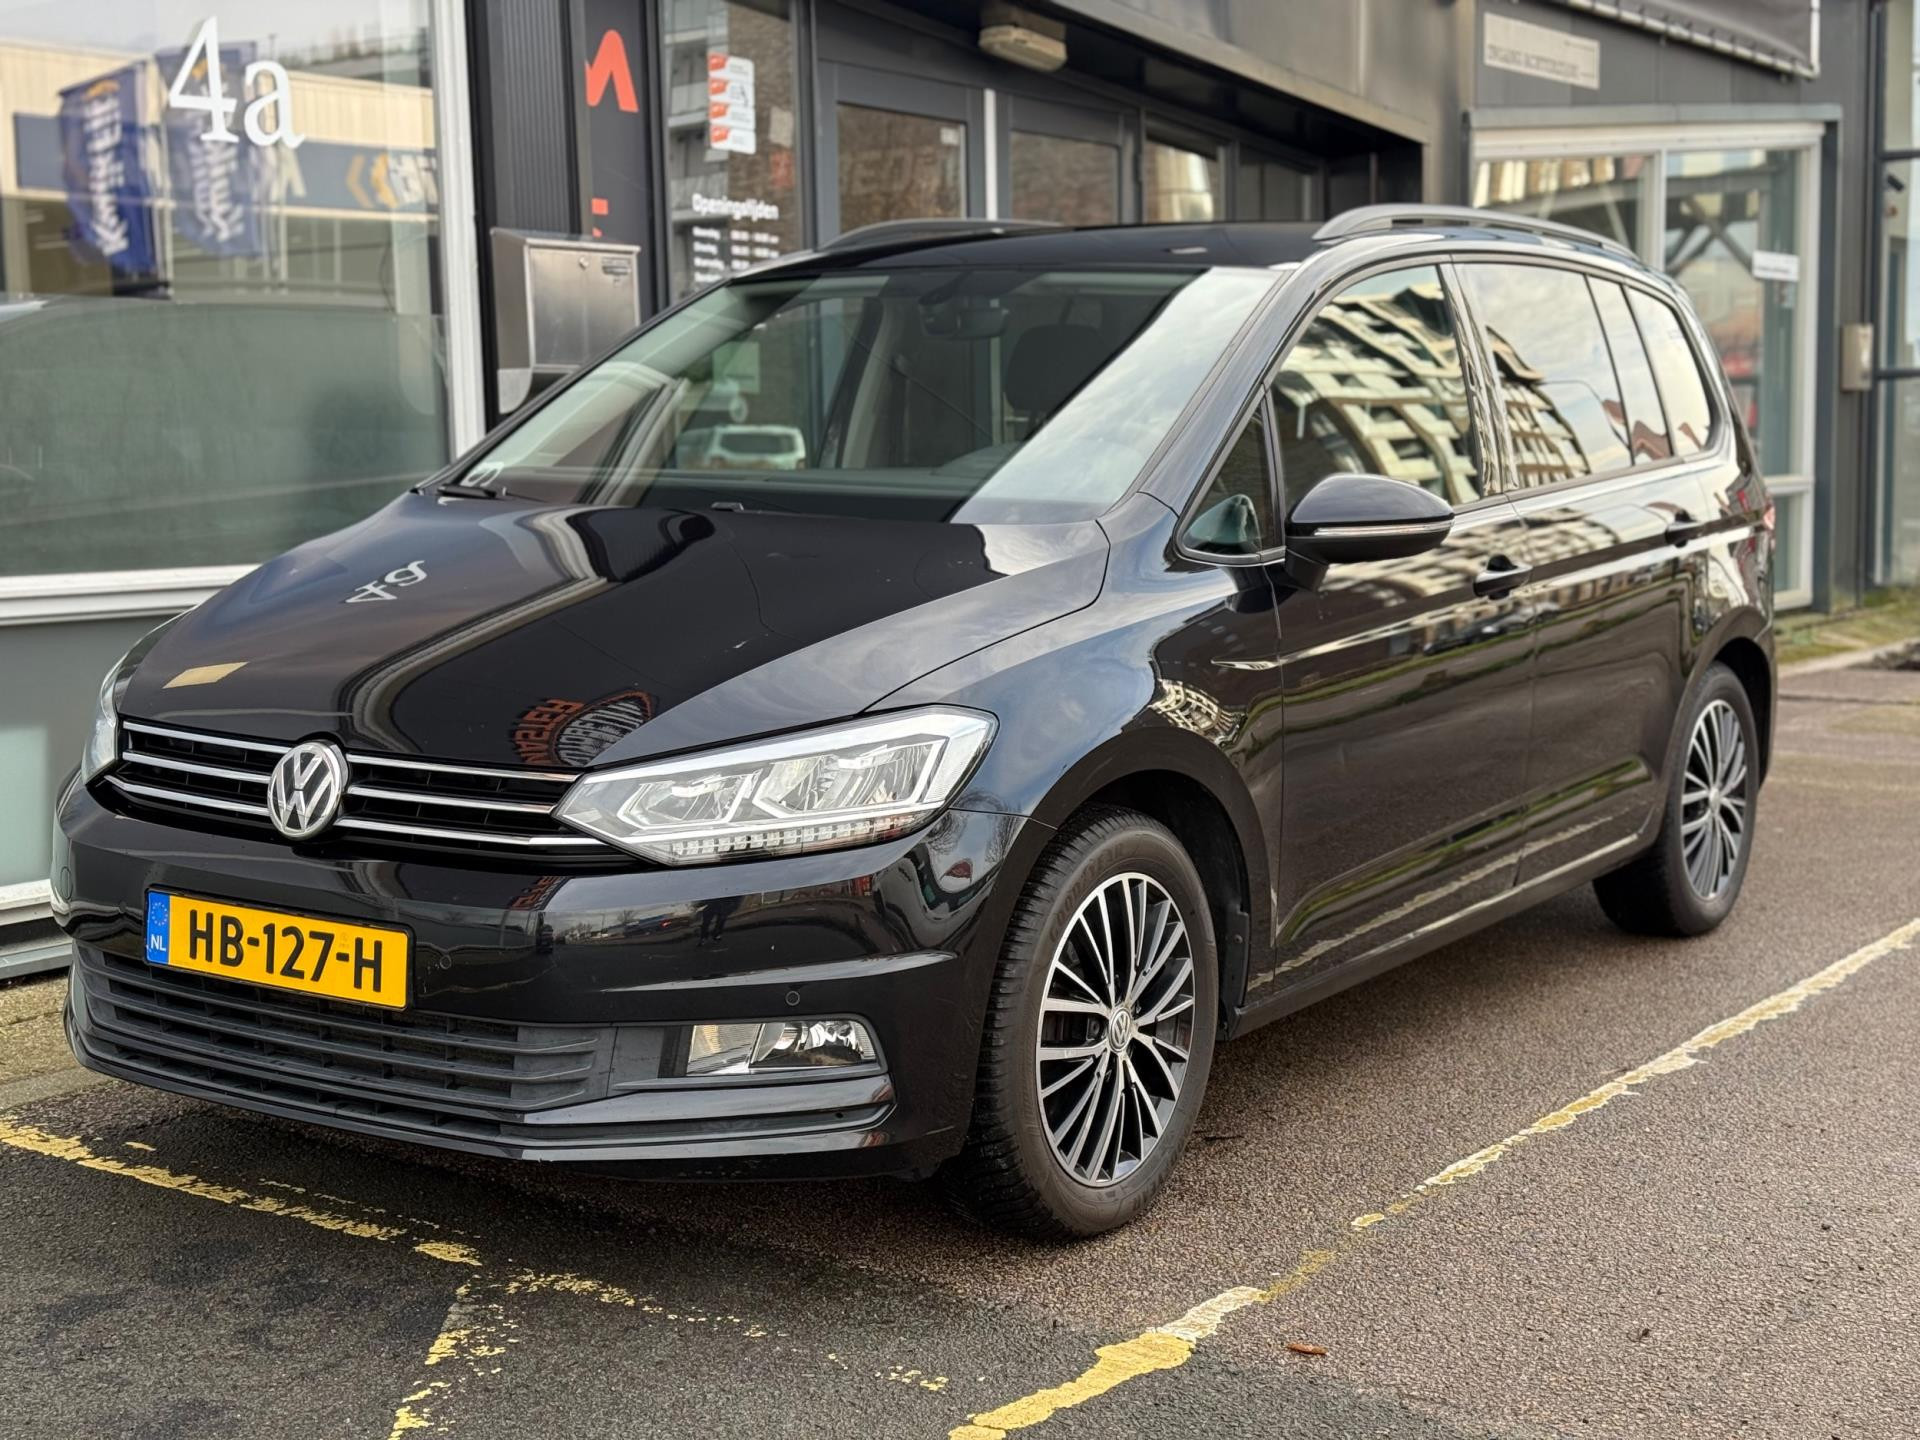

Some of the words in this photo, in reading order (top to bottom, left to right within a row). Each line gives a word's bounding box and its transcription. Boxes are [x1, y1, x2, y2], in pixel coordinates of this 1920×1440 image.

[168, 15, 306, 149] 4a
[150, 933, 167, 952] NL
[189, 909, 383, 993] HB-127-H
